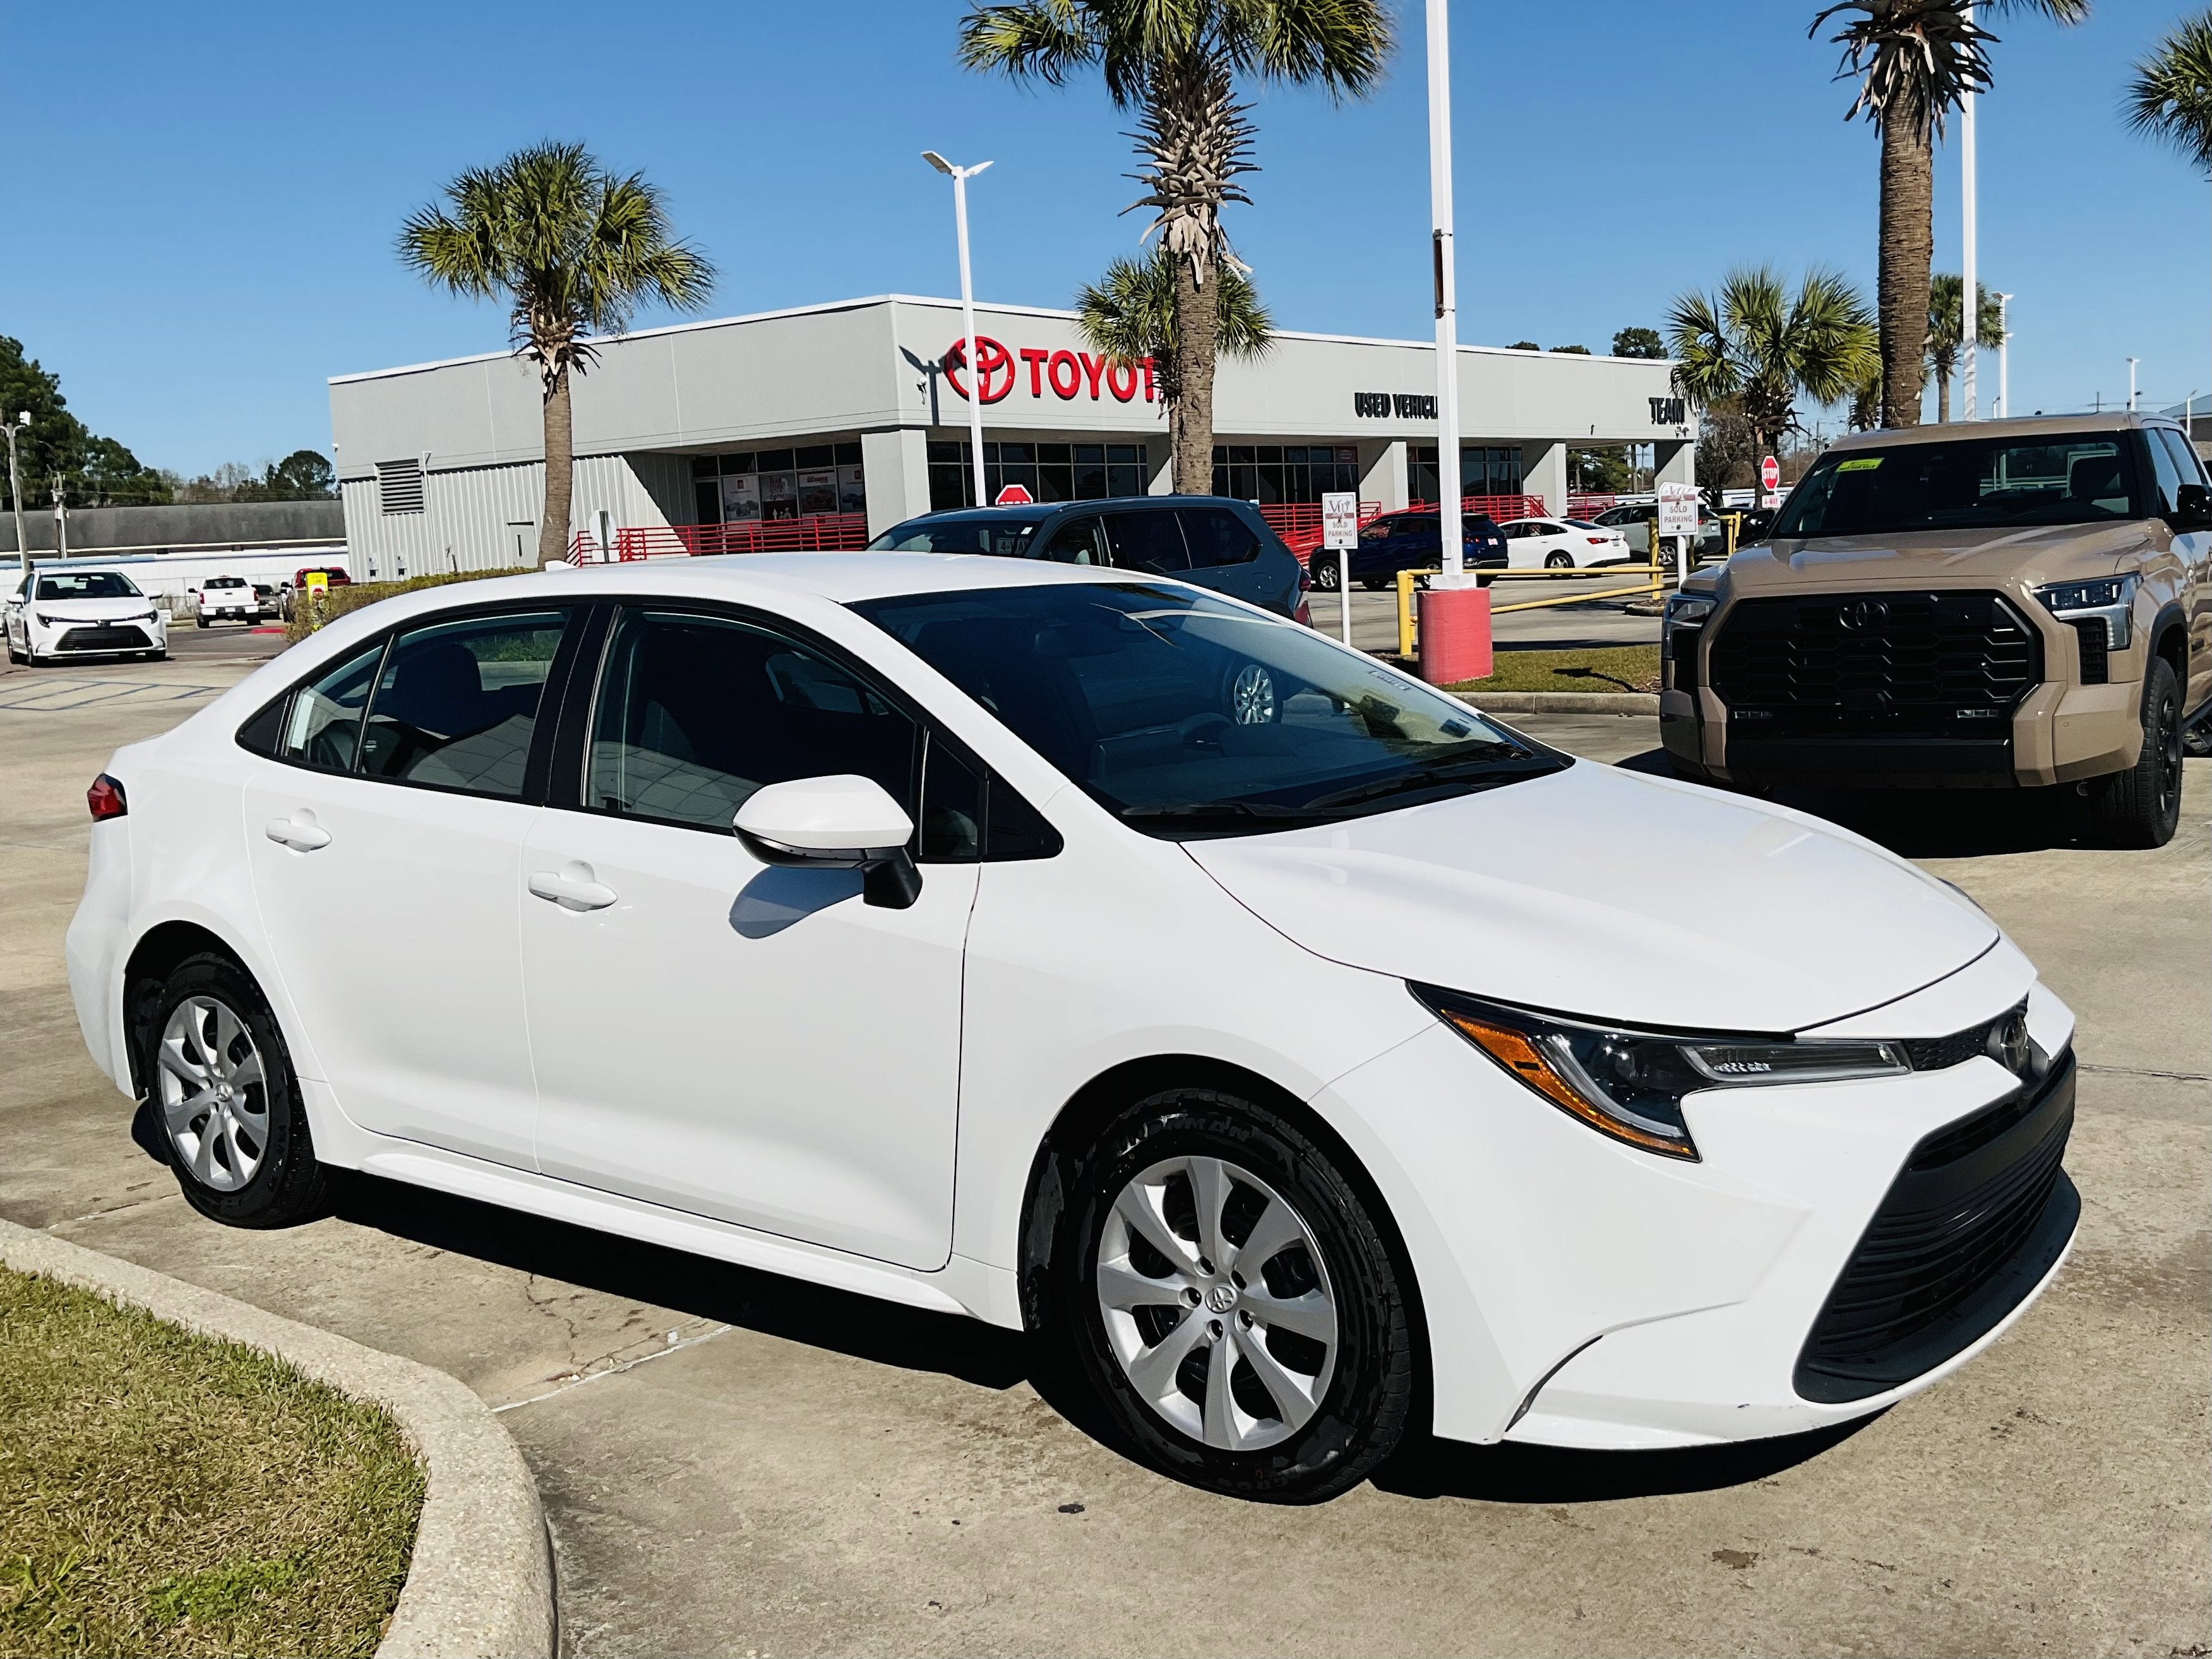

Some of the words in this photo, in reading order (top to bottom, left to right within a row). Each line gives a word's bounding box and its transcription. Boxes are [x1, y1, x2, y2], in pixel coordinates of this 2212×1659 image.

[1020, 349, 1164, 403] TOYOT
[1354, 393, 1390, 417] USED
[1392, 394, 1438, 419] VEHICL
[1649, 397, 1685, 424] TEAM
[1763, 467, 1778, 480] STOP
